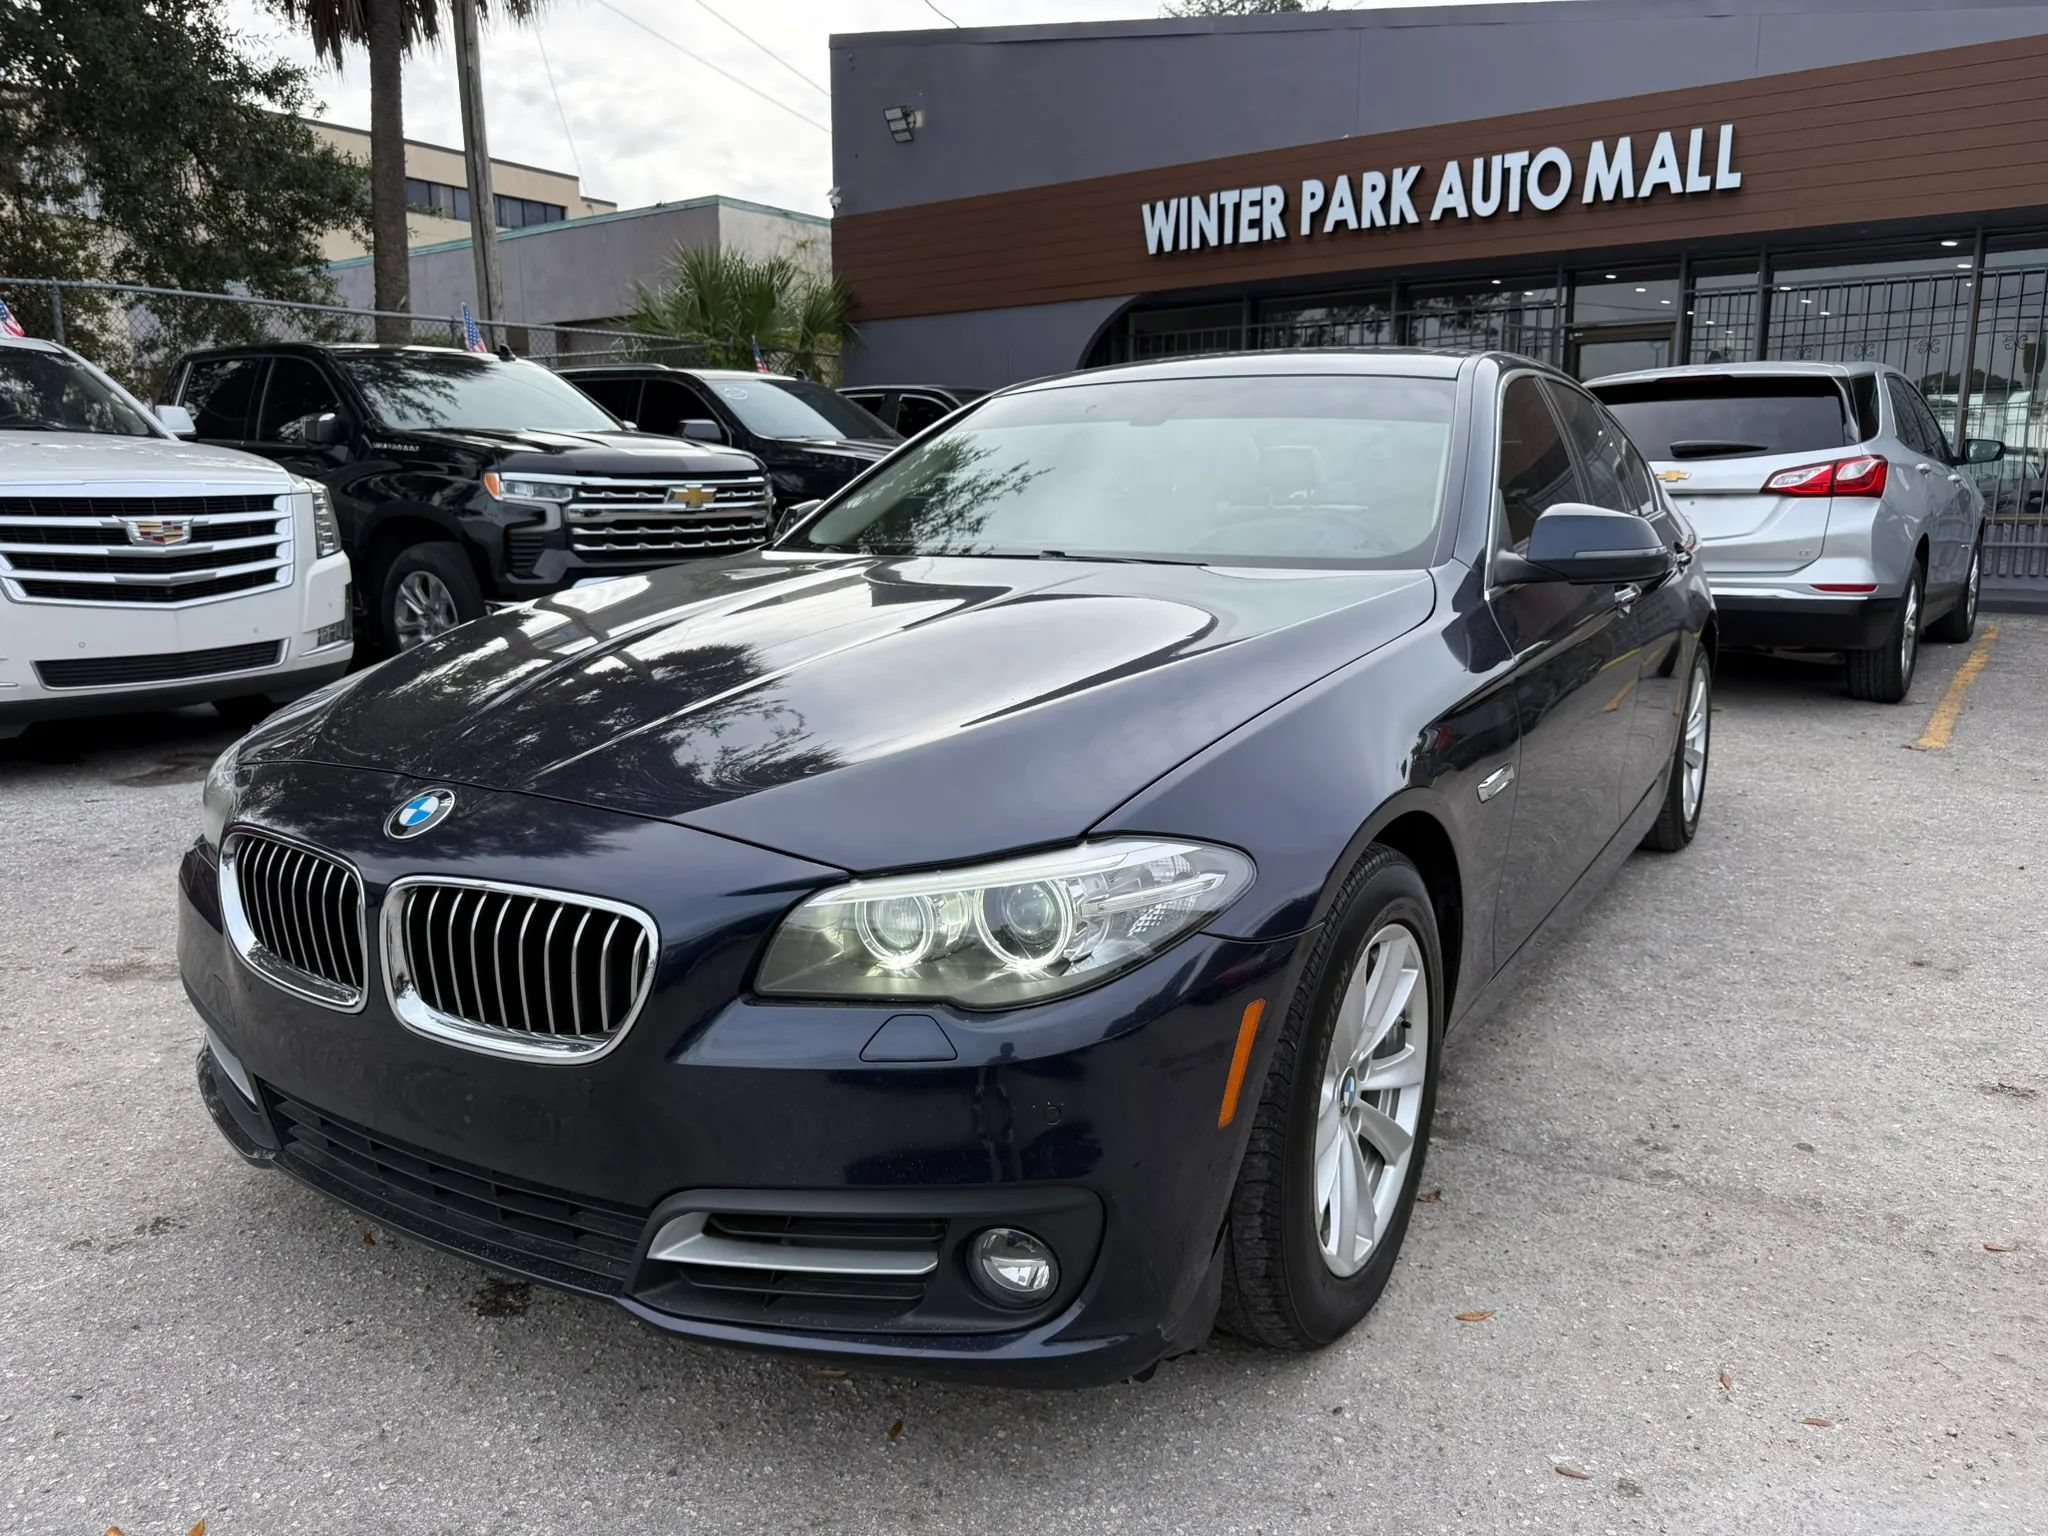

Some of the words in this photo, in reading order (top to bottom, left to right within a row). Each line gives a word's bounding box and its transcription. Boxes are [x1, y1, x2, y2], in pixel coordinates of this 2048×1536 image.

[1141, 185, 1287, 255] WINTER
[1300, 165, 1421, 236] PARK
[1429, 146, 1573, 221] AUTO
[1581, 123, 1742, 204] MALL
